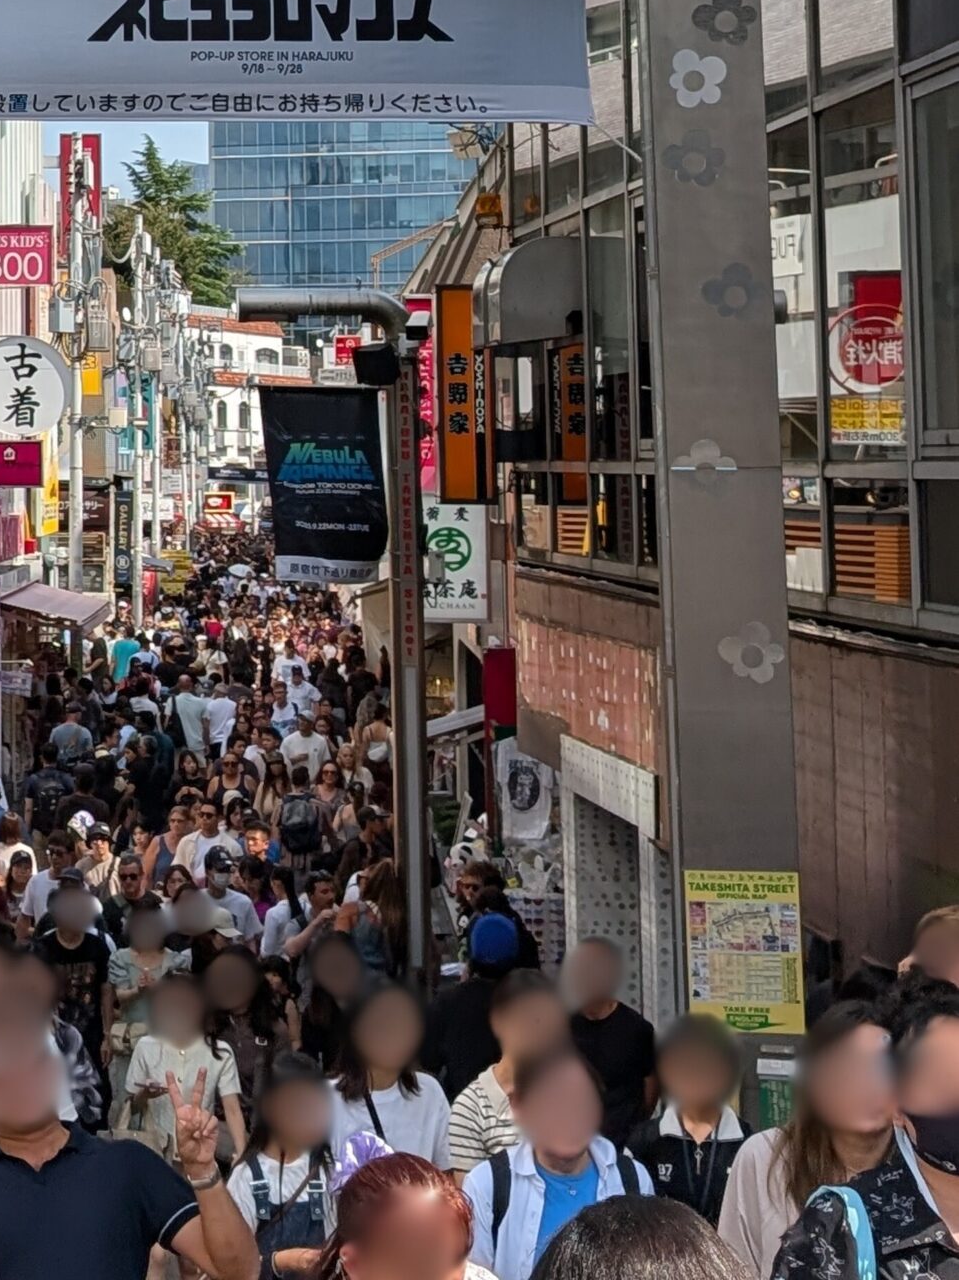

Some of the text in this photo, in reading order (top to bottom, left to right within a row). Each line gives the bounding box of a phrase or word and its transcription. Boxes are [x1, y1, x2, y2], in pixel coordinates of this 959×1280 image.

[190, 51, 354, 62] POP-UP STORE IN HARAJUKU
[10, 235, 44, 248] KID'S
[4, 343, 43, 428] 古着
[447, 353, 470, 434] 吉野家
[474, 354, 485, 434] YOSHINOYA
[285, 442, 369, 464] NEBULA
[119, 505, 129, 551] GALLERY
[688, 882, 796, 894] TAKESHITA STREET
